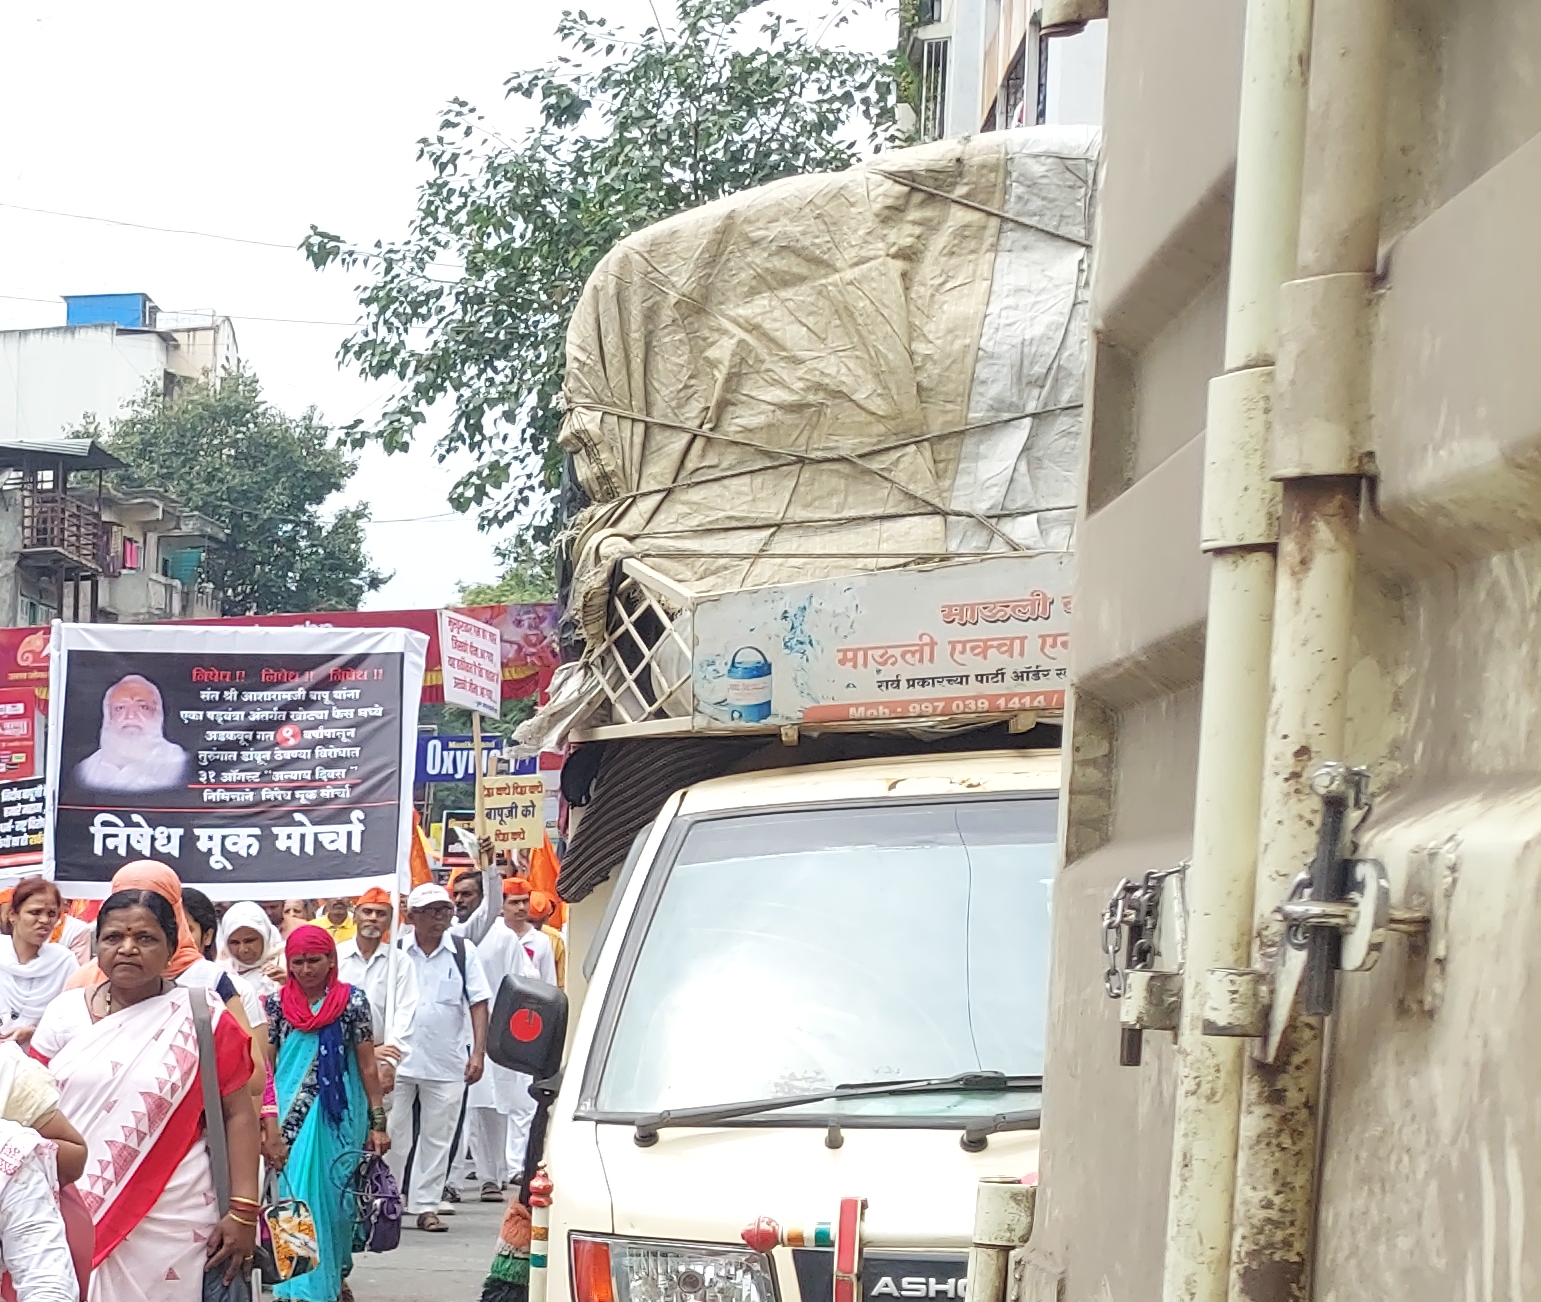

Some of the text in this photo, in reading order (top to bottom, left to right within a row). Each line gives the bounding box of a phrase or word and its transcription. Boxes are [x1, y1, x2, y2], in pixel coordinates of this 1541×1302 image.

[940, 589, 1054, 626] माऊली
[836, 632, 939, 670] माऊली
[947, 635, 1029, 667] एक्वा
[905, 673, 970, 690] प्रकारच्या
[974, 667, 1007, 686] पार्टी
[908, 701, 946, 716] 997
[951, 698, 990, 713] 039
[996, 693, 1046, 710] 1414
[485, 801, 519, 826] बापूजी
[520, 799, 537, 819] को
[88, 809, 367, 871] निषेध मूक मोर्चा
[870, 1276, 967, 1299] ASH
